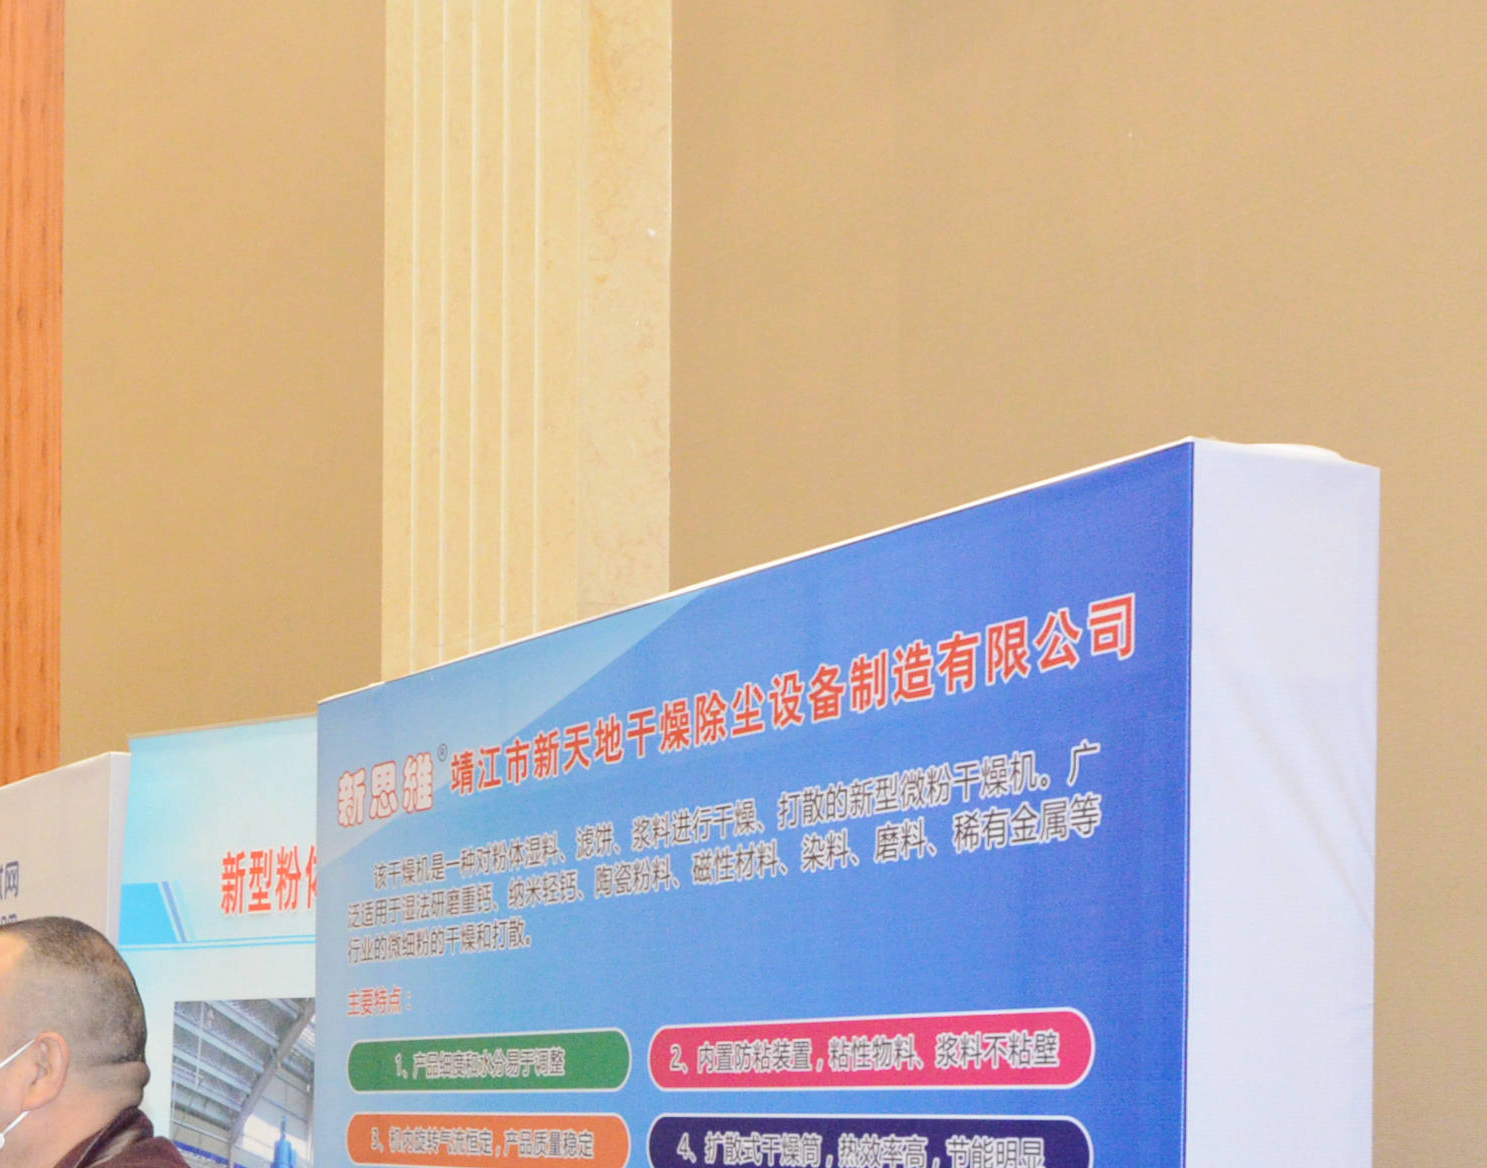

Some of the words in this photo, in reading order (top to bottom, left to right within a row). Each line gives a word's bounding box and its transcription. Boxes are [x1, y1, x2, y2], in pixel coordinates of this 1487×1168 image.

[337, 752, 434, 828] 新思维
[450, 593, 1137, 797] 靖江市新天地干燥除尘设备制造有限公司
[347, 918, 532, 964] 行业的微细粉的干燥和打散。
[670, 1030, 1060, 1074] 2、内置防粘装置，粘性物料、浆料不粘壁
